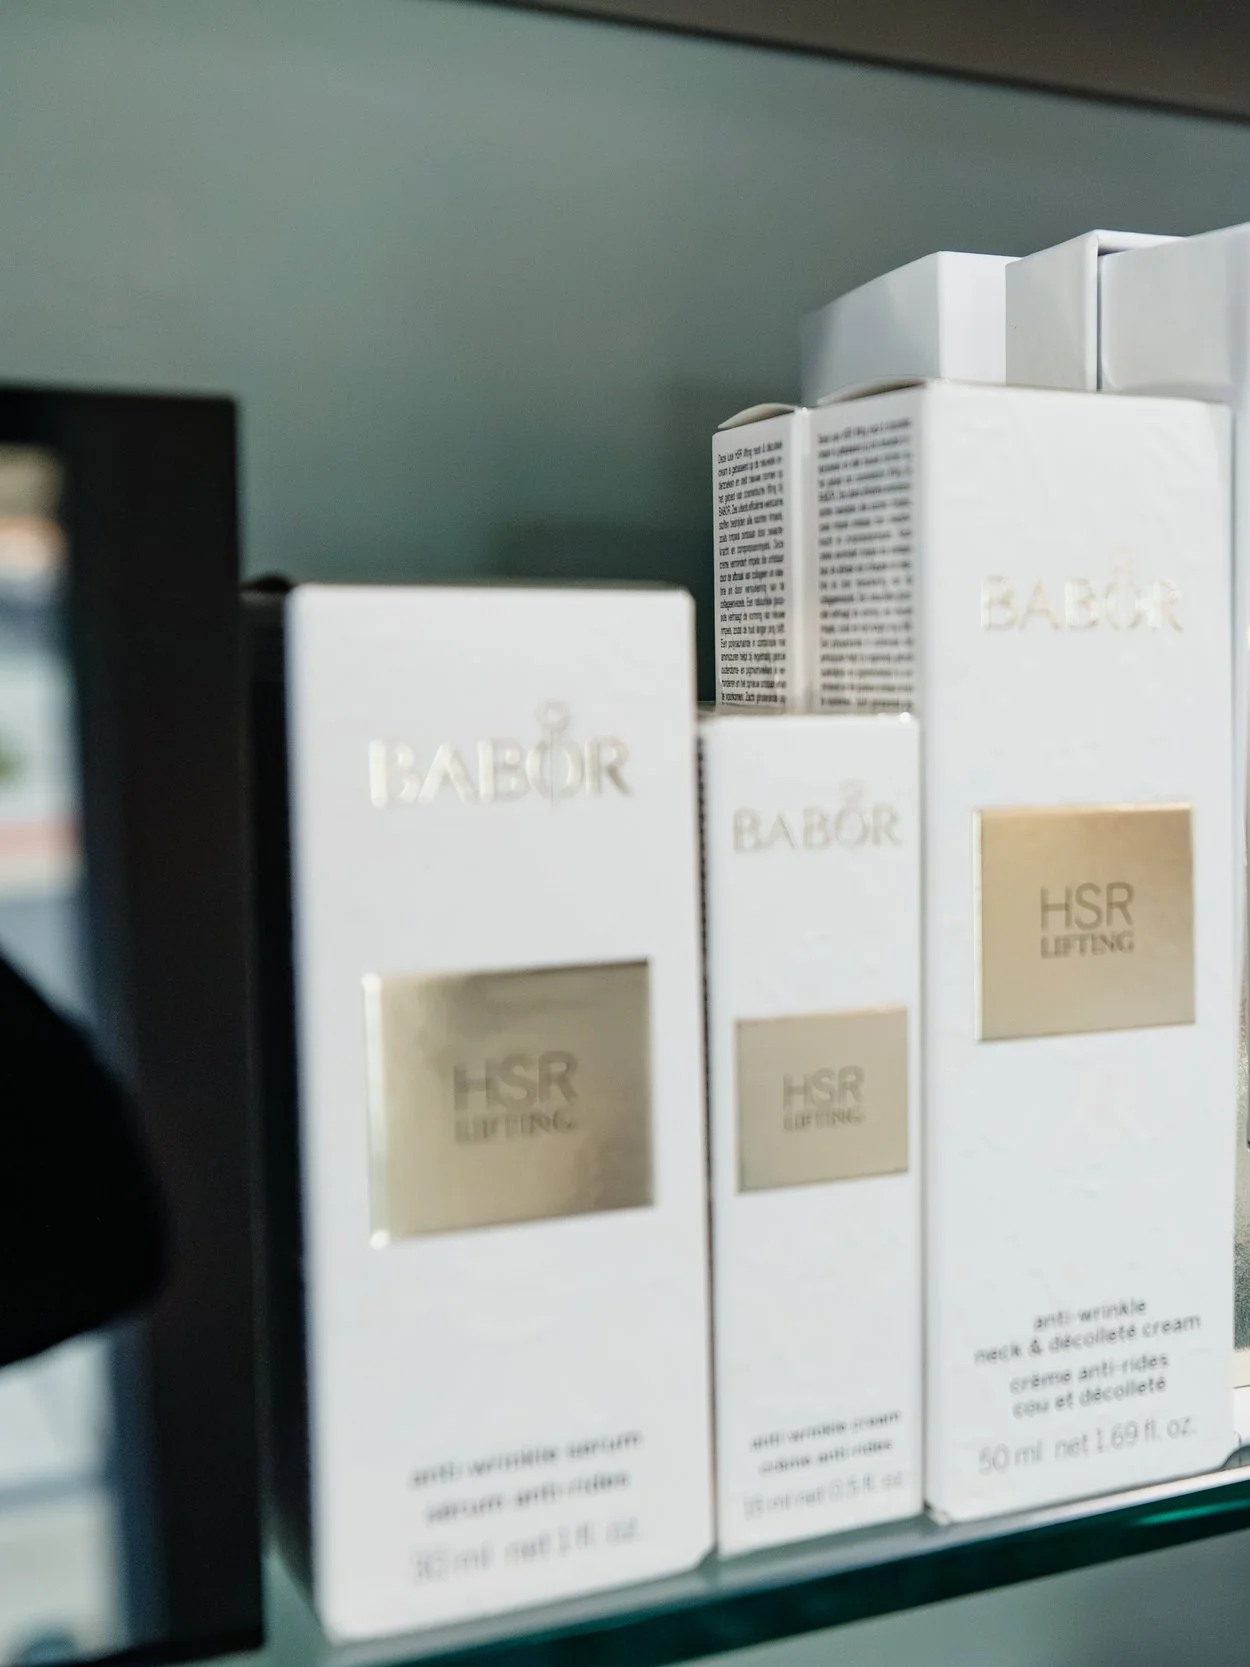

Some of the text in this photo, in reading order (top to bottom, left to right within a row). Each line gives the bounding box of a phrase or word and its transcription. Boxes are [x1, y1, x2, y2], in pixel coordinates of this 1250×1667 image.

[980, 573, 1184, 634] BABOR
[368, 734, 637, 811] BABOR
[732, 801, 903, 854] BABOR
[1040, 882, 1135, 931] HSR
[1040, 930, 1135, 960] LIFTING
[453, 1050, 578, 1111] HSR
[783, 1065, 865, 1110] HSR
[455, 1108, 578, 1146] LIFTING
[782, 1108, 866, 1133] LIFTING
[1033, 1297, 1147, 1332] anti-wrinkle
[974, 1314, 1201, 1366] neck & décolleté cream
[1010, 1351, 1169, 1394] crème anti-rides
[1012, 1376, 1166, 1419] cou et décolleté
[978, 1443, 1010, 1476] 50
[1014, 1439, 1043, 1467] ml
[1054, 1433, 1089, 1460] net
